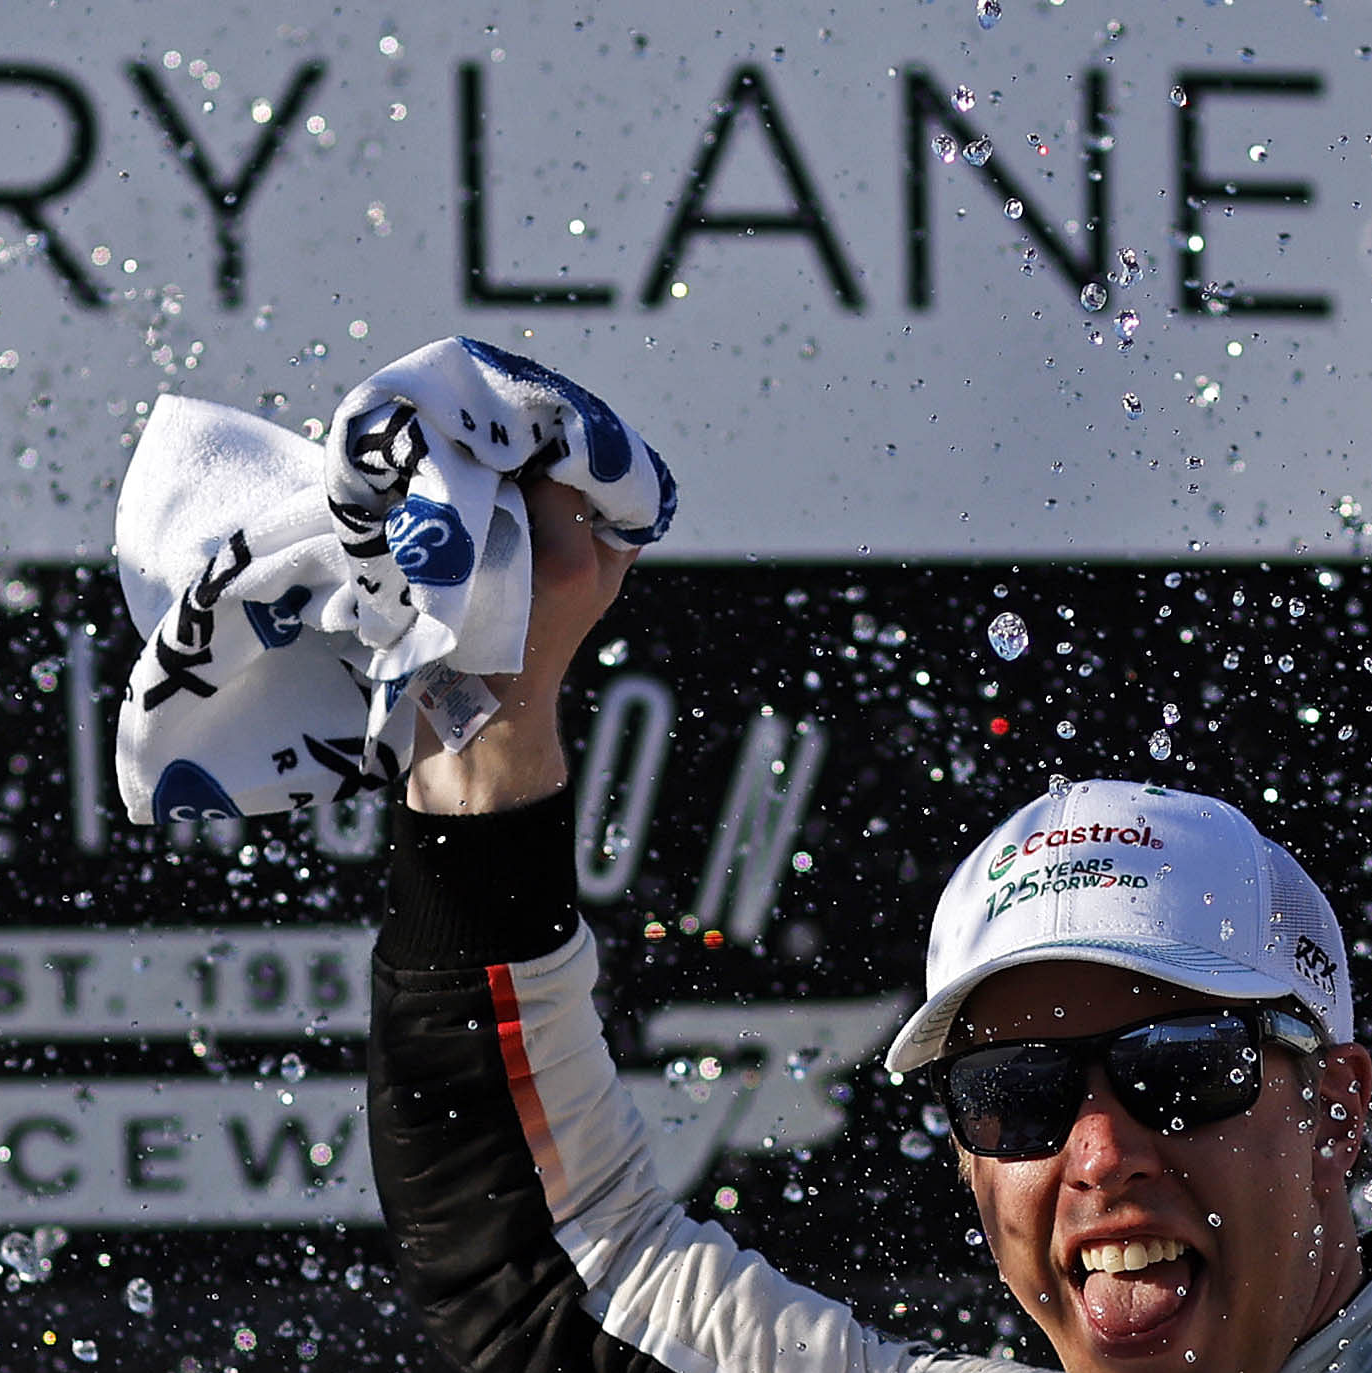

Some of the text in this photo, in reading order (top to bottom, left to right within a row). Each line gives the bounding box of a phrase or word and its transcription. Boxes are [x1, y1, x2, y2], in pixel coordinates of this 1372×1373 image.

[459, 62, 1335, 318] LANE
[1023, 823, 1152, 856] Castrol
[986, 858, 1114, 922] 125 YEARS
